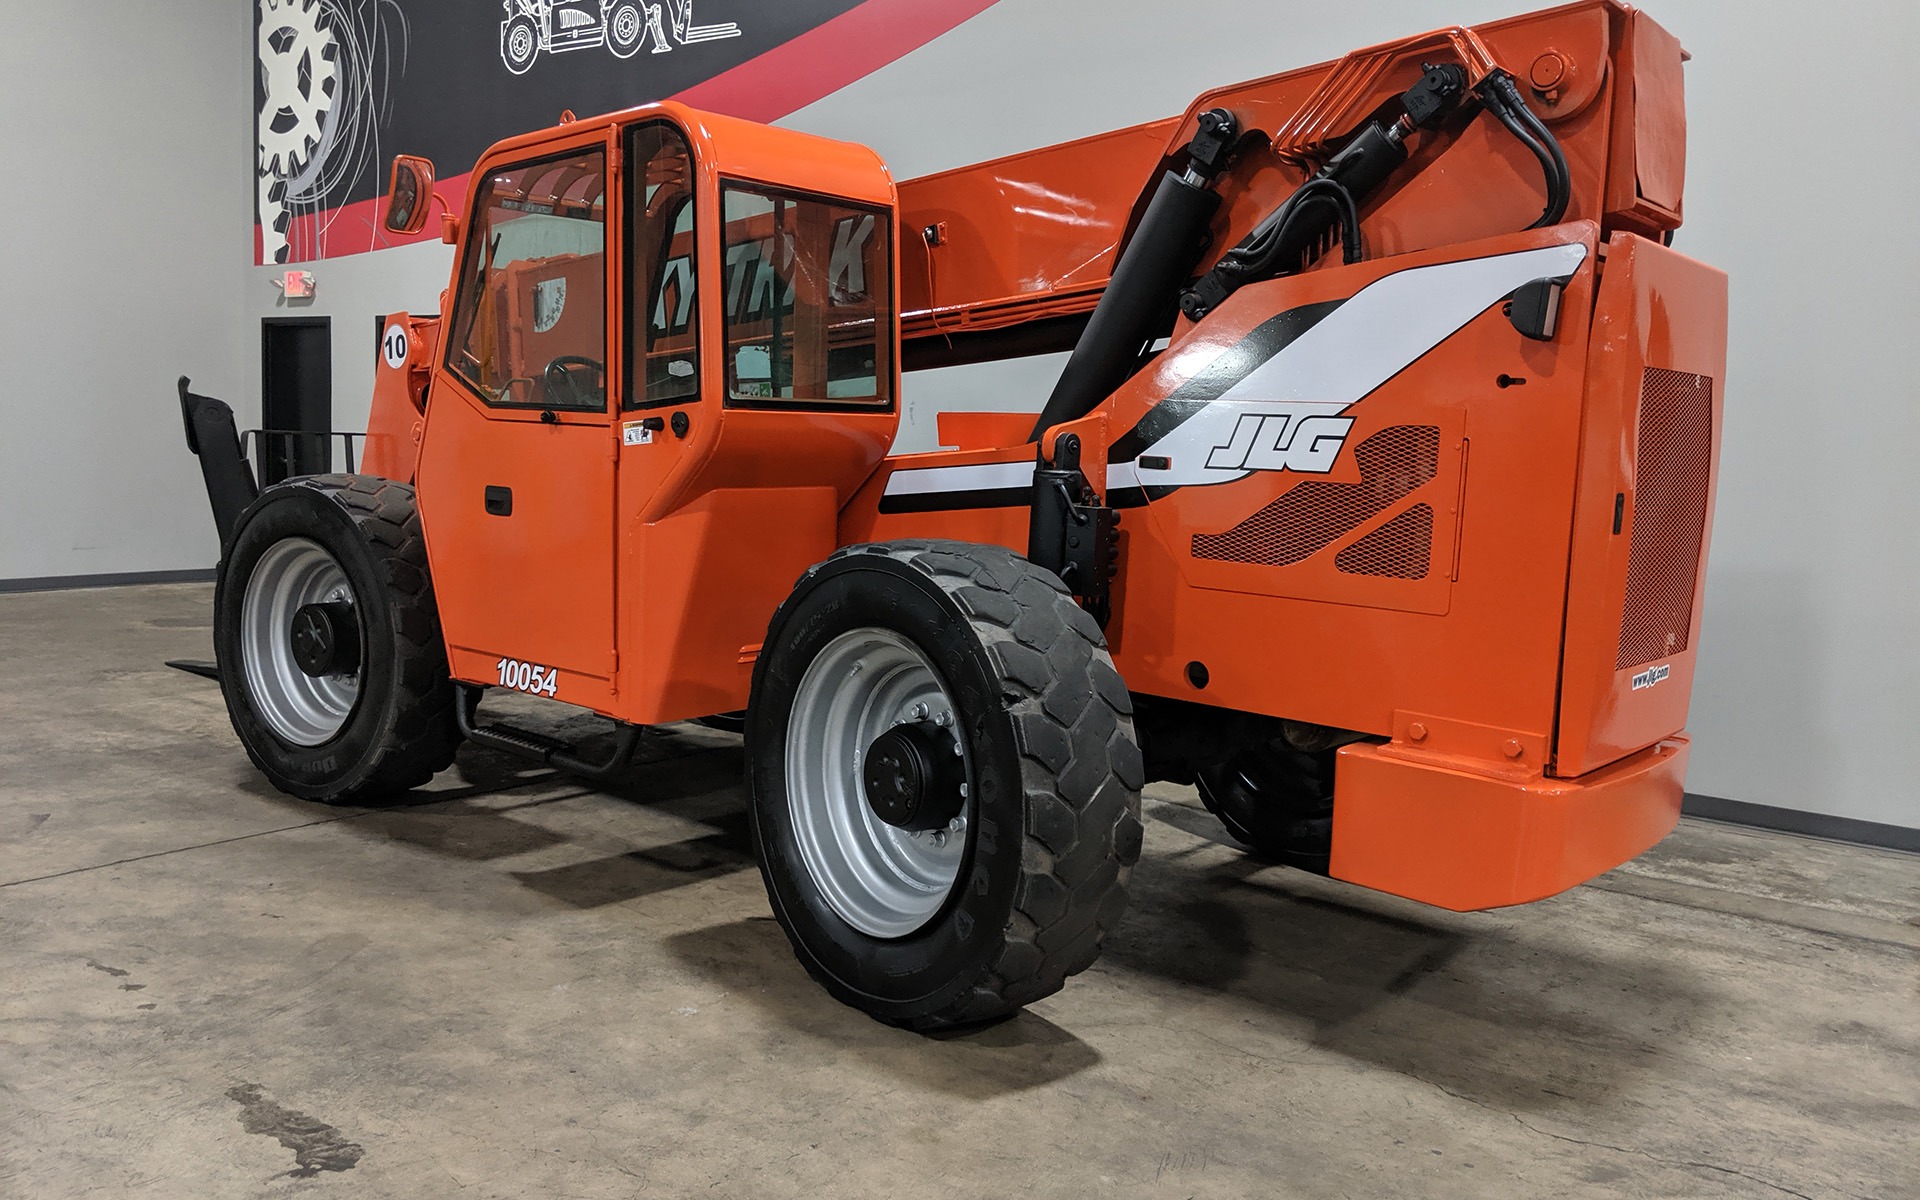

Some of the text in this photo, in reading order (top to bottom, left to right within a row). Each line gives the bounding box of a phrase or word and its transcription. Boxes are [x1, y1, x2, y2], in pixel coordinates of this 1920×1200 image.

[385, 334, 406, 360] 10
[1205, 413, 1357, 473] JLG
[497, 656, 558, 698] 10054
